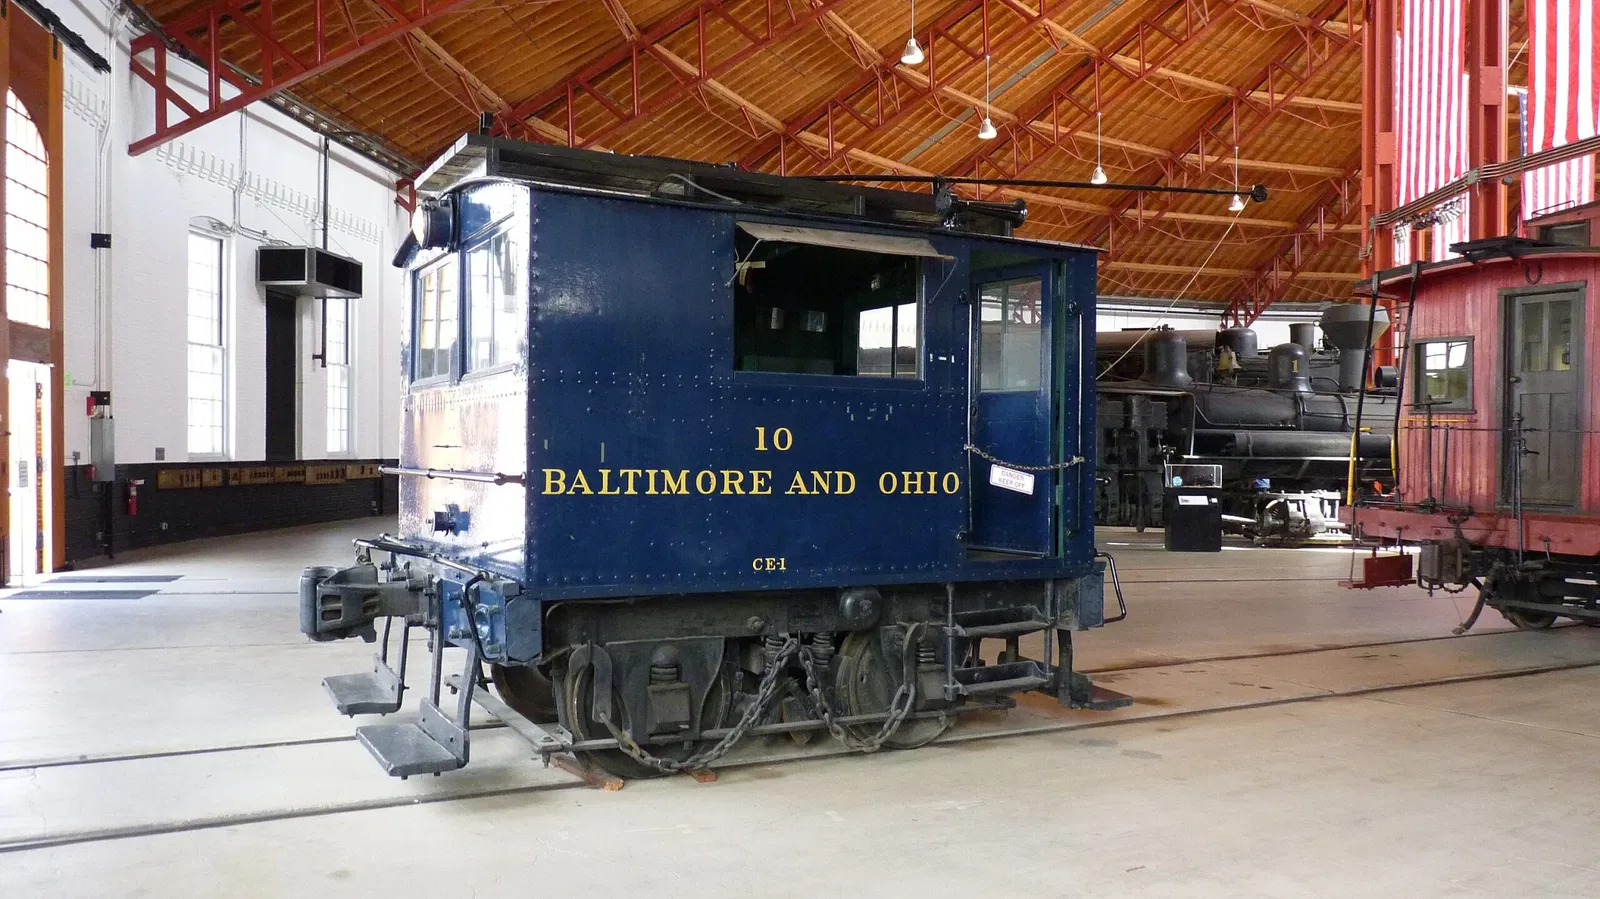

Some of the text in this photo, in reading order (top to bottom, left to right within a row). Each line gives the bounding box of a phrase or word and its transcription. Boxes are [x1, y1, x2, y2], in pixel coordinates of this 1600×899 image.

[1291, 359, 1299, 373] 1
[754, 426, 793, 451] 10
[541, 468, 962, 496] BALTIMORE AND OHIO
[1001, 470, 1025, 480] DANGER
[998, 477, 1026, 489] KEEP OFF
